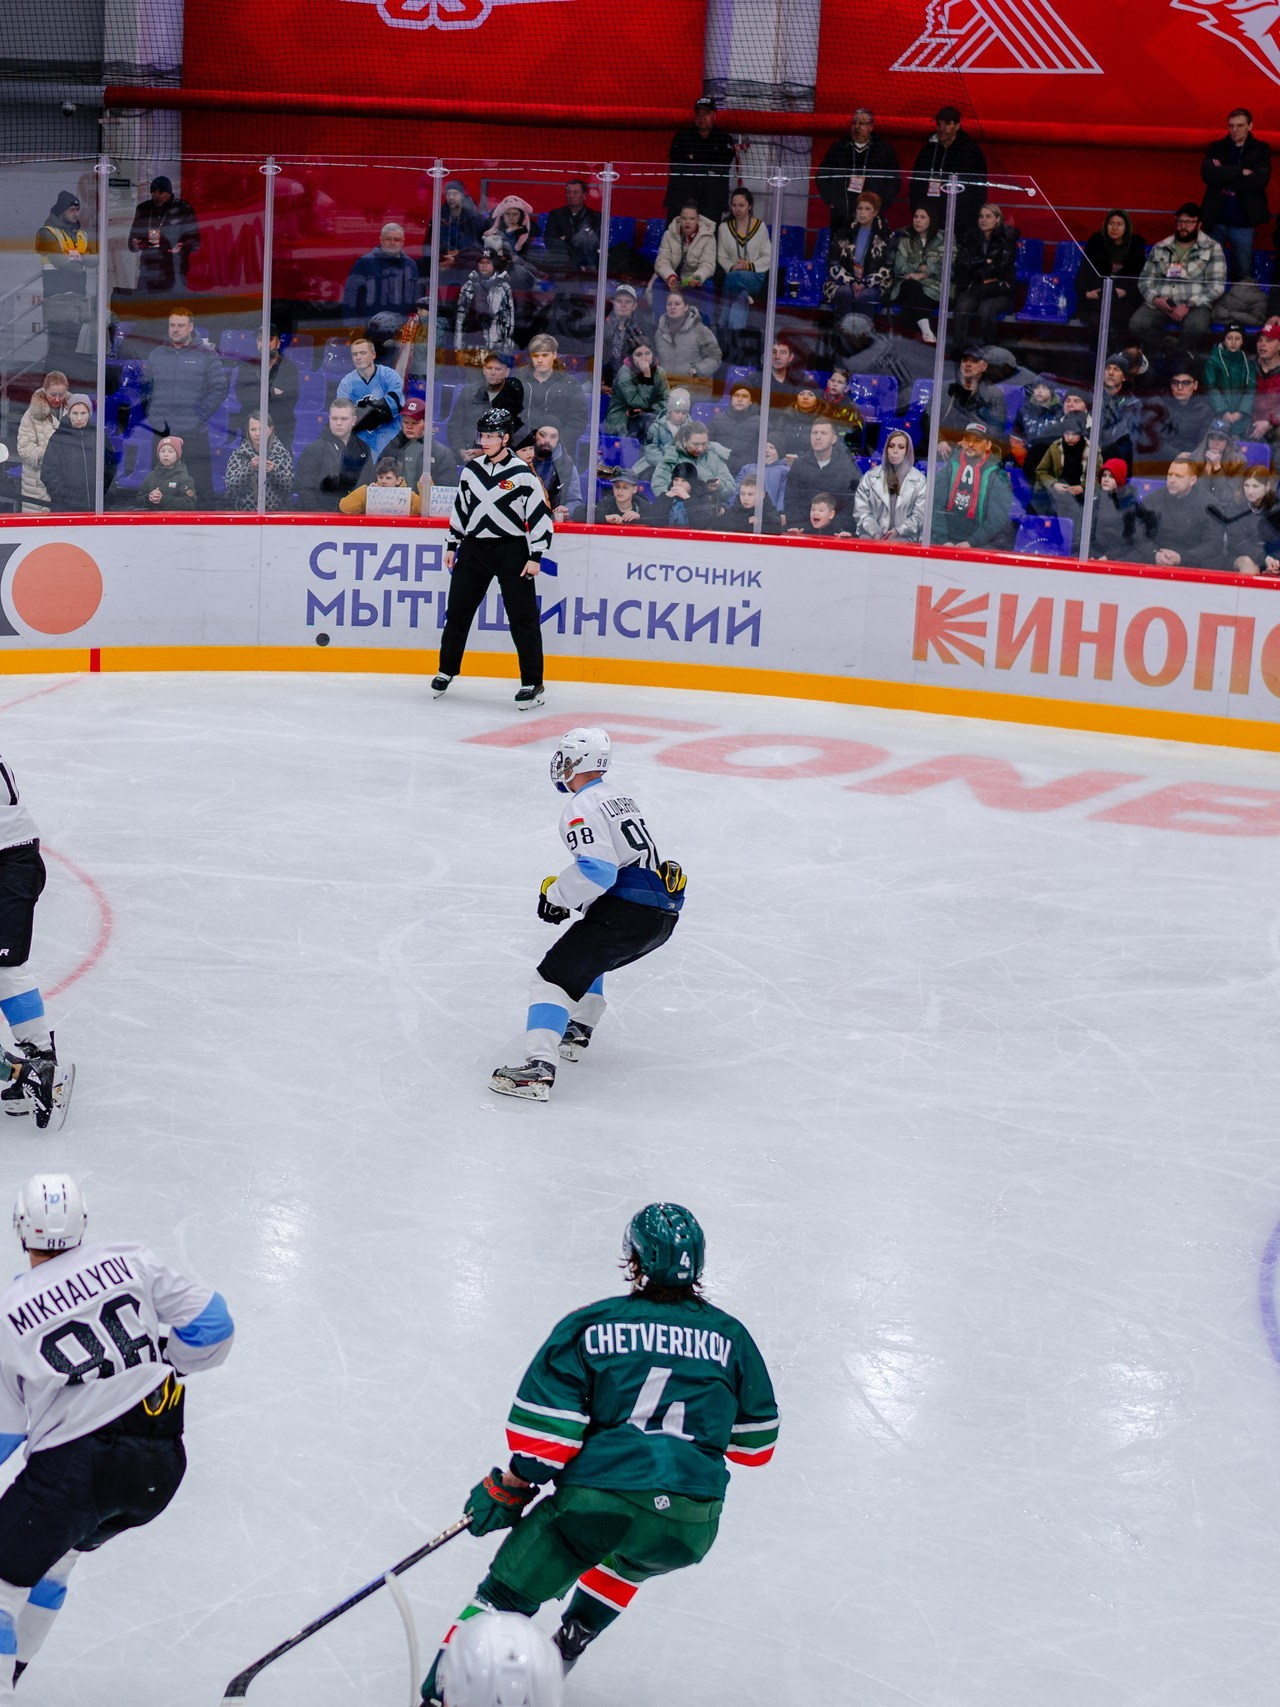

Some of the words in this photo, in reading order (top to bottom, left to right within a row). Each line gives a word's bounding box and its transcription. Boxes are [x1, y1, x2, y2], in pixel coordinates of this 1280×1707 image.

[309, 541, 446, 582] СТАР
[627, 562, 763, 589] ИСТОЧНИК
[596, 758, 608, 768] 98
[566, 827, 595, 851] 98
[47, 1238, 66, 1249] 86
[679, 1251, 691, 1268] 4
[7, 1256, 134, 1336] MIKHALYOV
[40, 1293, 158, 1386] 86
[585, 1323, 732, 1367] CHETVERIKOV
[626, 1366, 695, 1441] 4
